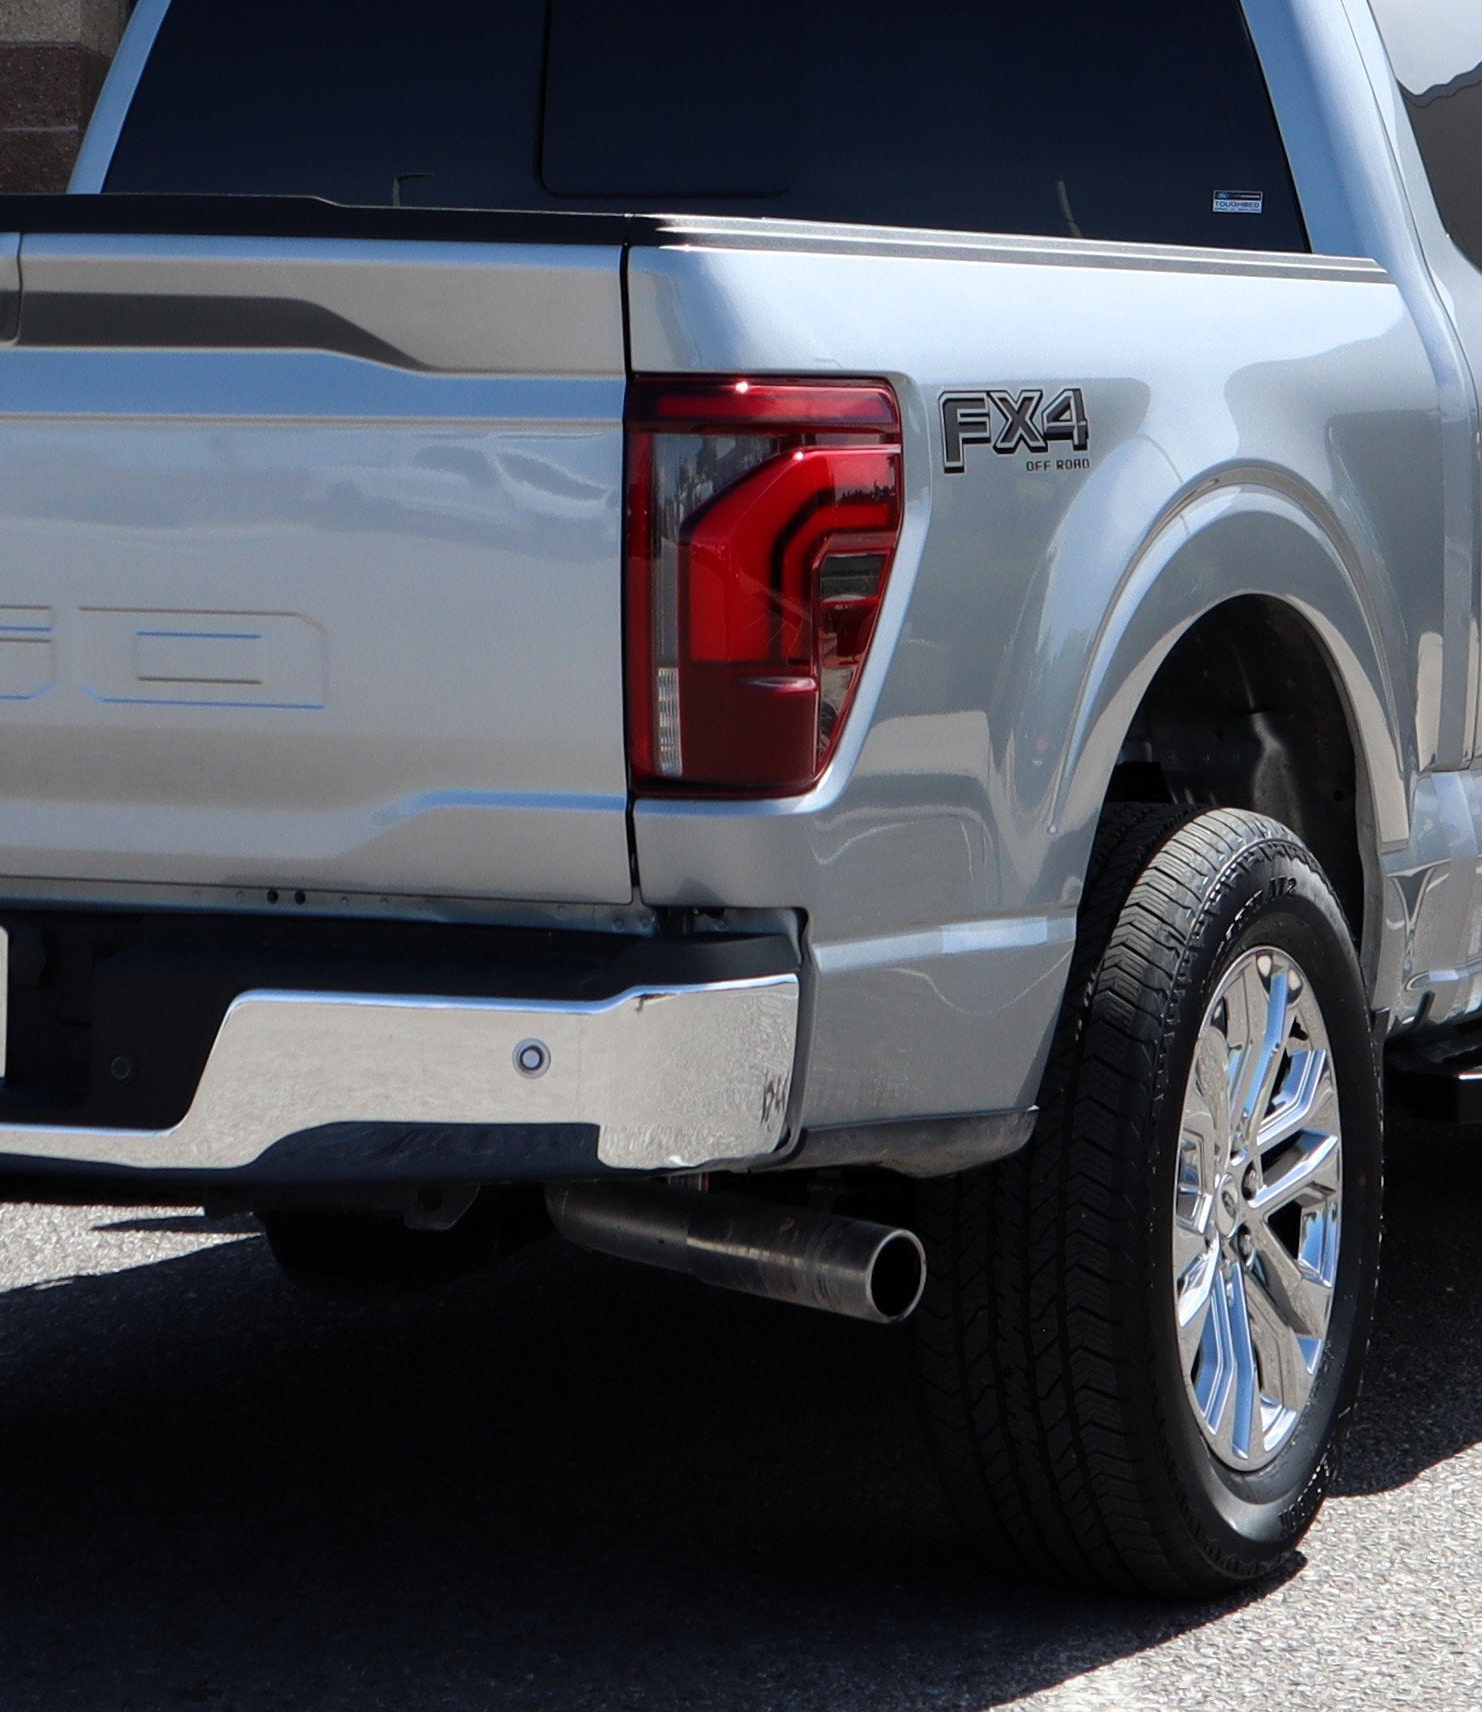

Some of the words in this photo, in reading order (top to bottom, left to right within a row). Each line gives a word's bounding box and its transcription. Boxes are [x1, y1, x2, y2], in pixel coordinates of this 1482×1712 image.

[938, 388, 1089, 473] FX4
[1026, 460, 1051, 472] OFF
[1056, 458, 1090, 470] ROAD
